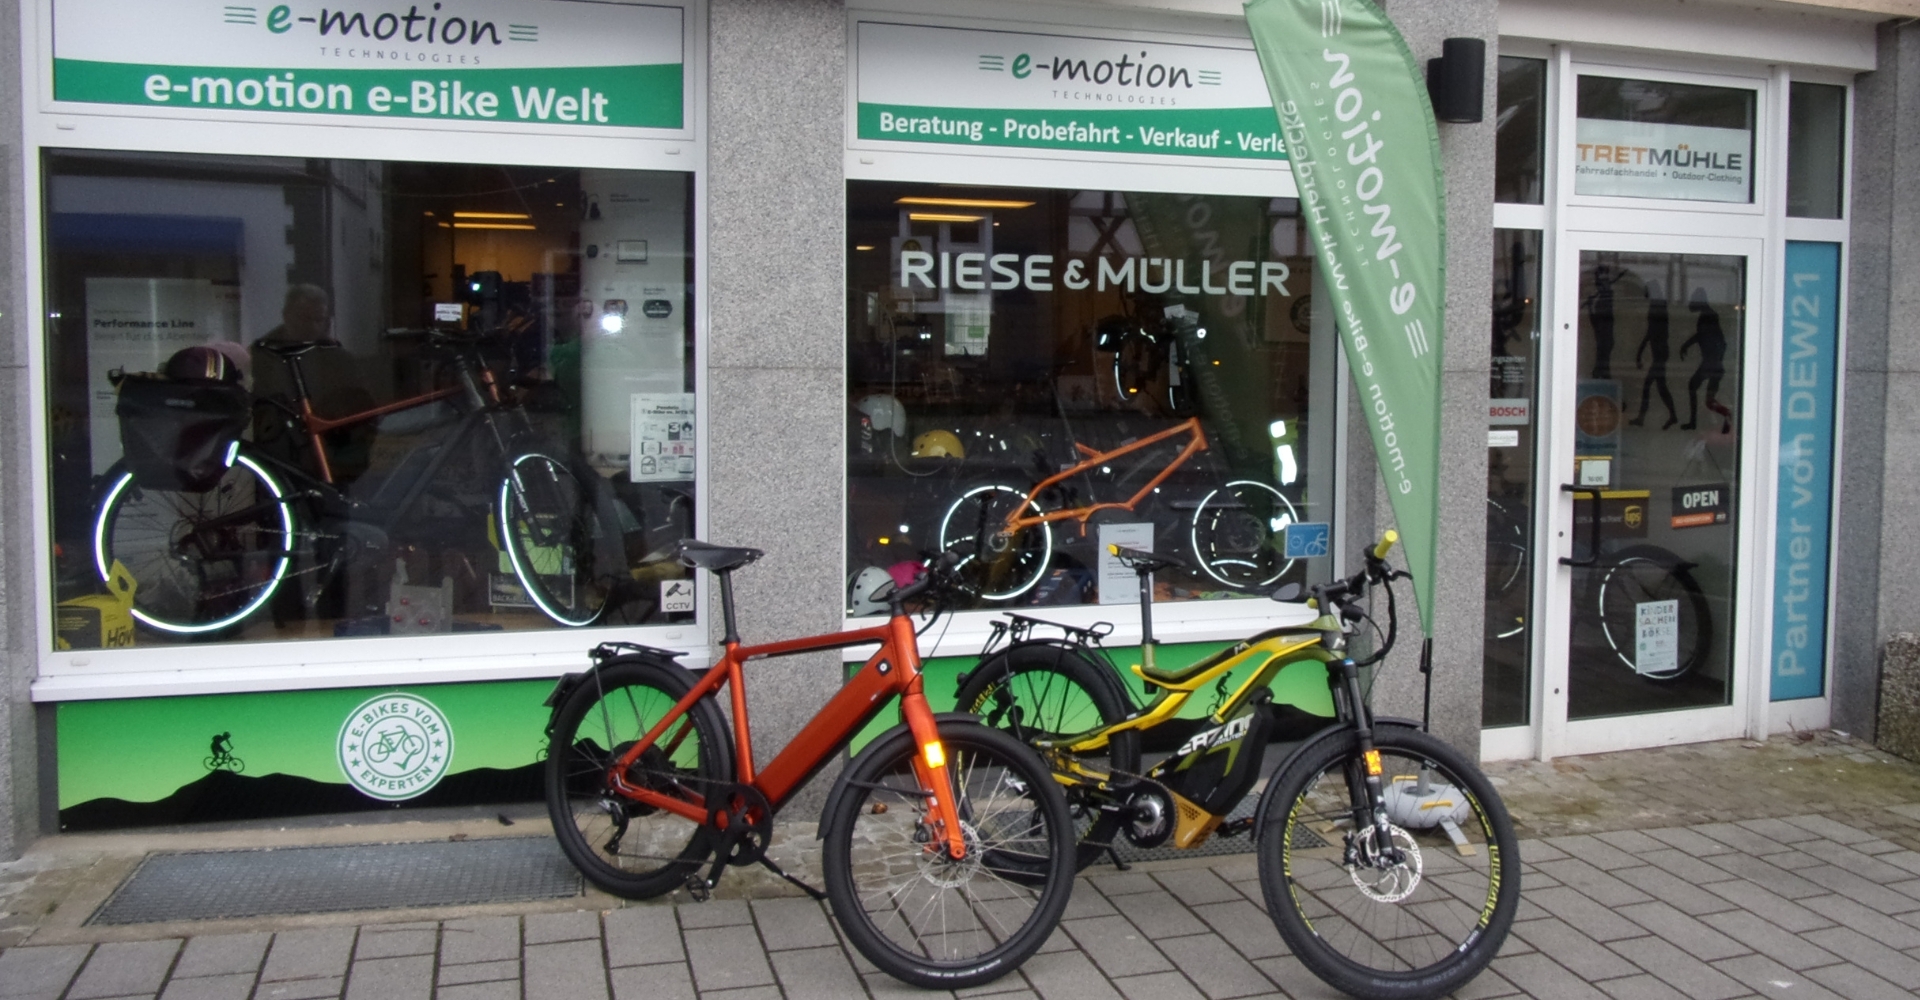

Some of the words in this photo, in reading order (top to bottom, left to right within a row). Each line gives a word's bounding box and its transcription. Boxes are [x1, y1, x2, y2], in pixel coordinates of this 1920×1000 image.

[266, 2, 503, 46] e-motion
[320, 46, 481, 65] TECHNOLOGIES
[1011, 51, 1193, 89] e-motion
[144, 73, 353, 111] e-motion
[367, 80, 499, 118] e-Bike
[511, 86, 609, 123] Welt
[1052, 90, 1178, 106] TECHNOLOGIES
[879, 112, 983, 141] Beratung
[1004, 119, 1120, 144] Probefahrt
[1139, 127, 1220, 150] Verkauf
[1237, 132, 1287, 154] Verle
[1576, 165, 1658, 178] Fahrradfachhandel
[1577, 143, 1742, 170] TRETMÜHLE
[901, 250, 1054, 291] RIESE
[1063, 260, 1091, 291] &
[1098, 256, 1291, 297] MÜLLER
[93, 319, 168, 328] Performance
[171, 319, 195, 328] Line
[1788, 272, 1820, 420] DEW21
[1490, 407, 1526, 417] BOSCH
[1790, 433, 1815, 508] von
[1683, 490, 1719, 509] OPEN
[666, 602, 690, 610] CCTV
[1778, 523, 1811, 677] Partner
[352, 703, 409, 737] E-BIKES
[415, 708, 440, 735] VOM
[360, 766, 433, 790] EXPERTEN
